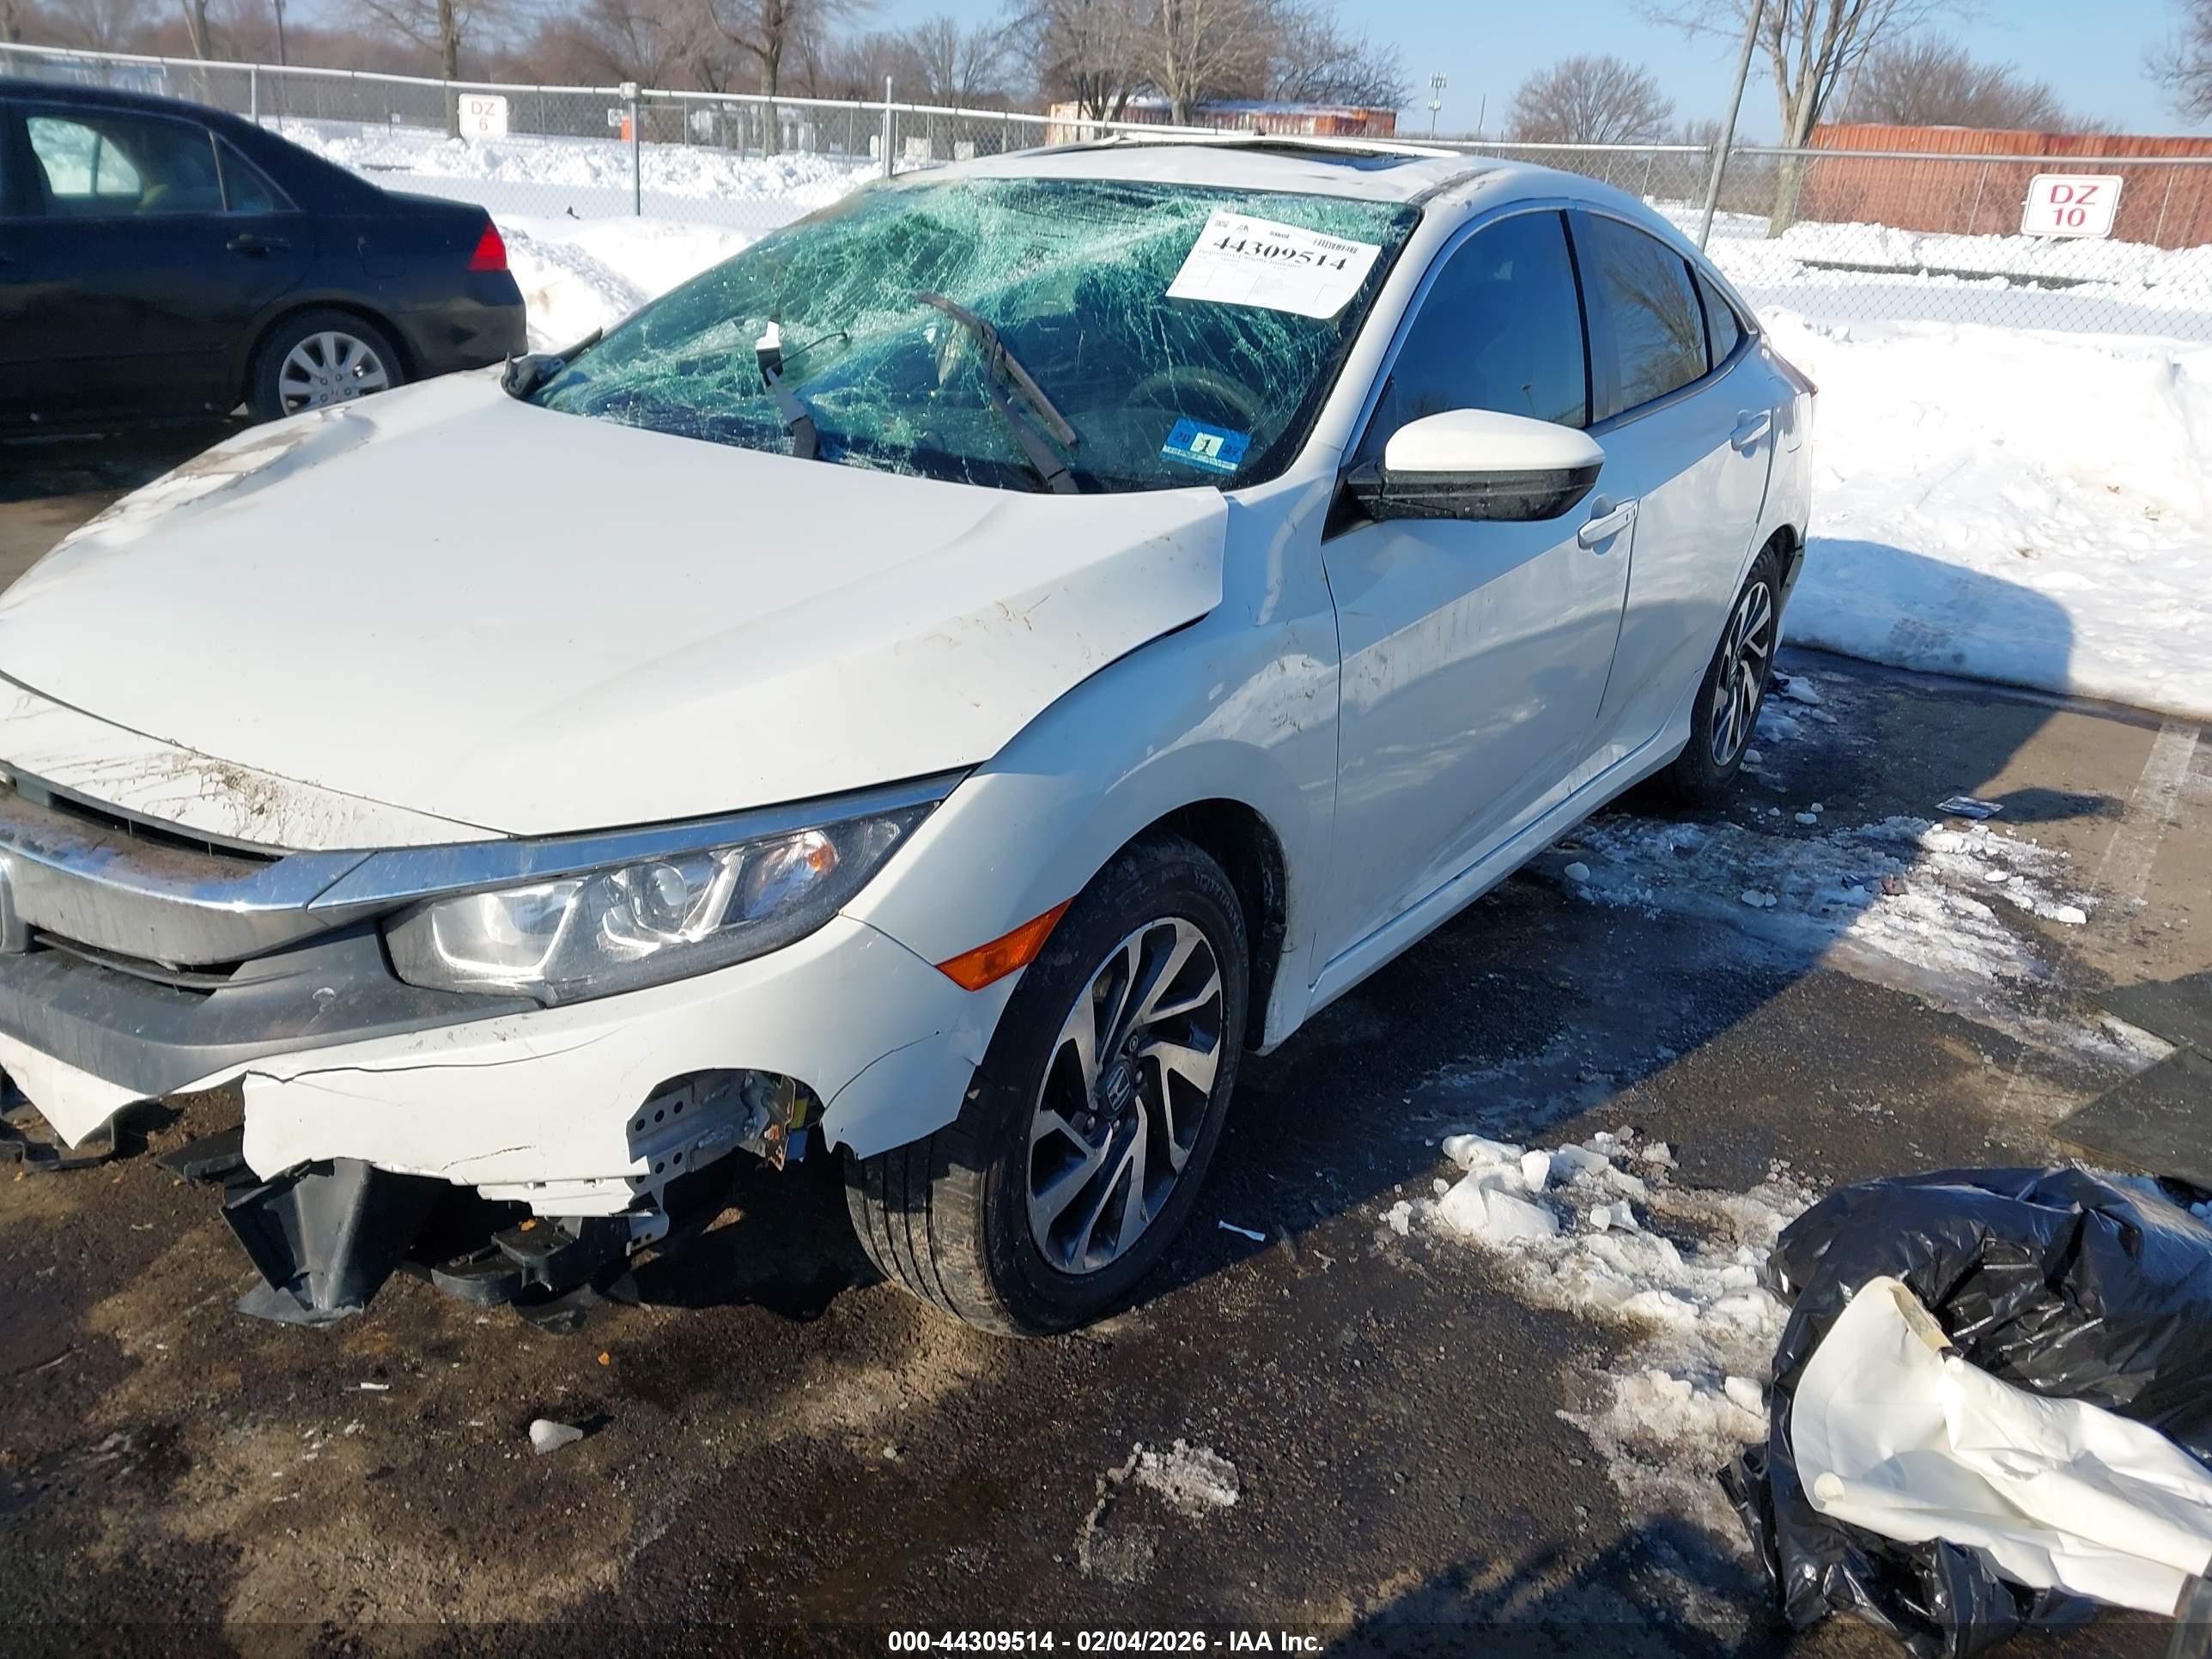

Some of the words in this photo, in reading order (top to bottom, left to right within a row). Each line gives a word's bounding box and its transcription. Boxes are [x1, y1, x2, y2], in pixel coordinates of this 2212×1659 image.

[471, 101, 495, 116] DZ
[479, 118, 488, 131] 6
[2050, 185, 2100, 204] DZ
[2052, 207, 2086, 227] 10
[1214, 236, 1346, 270] 44309514
[1200, 440, 1211, 453] 1
